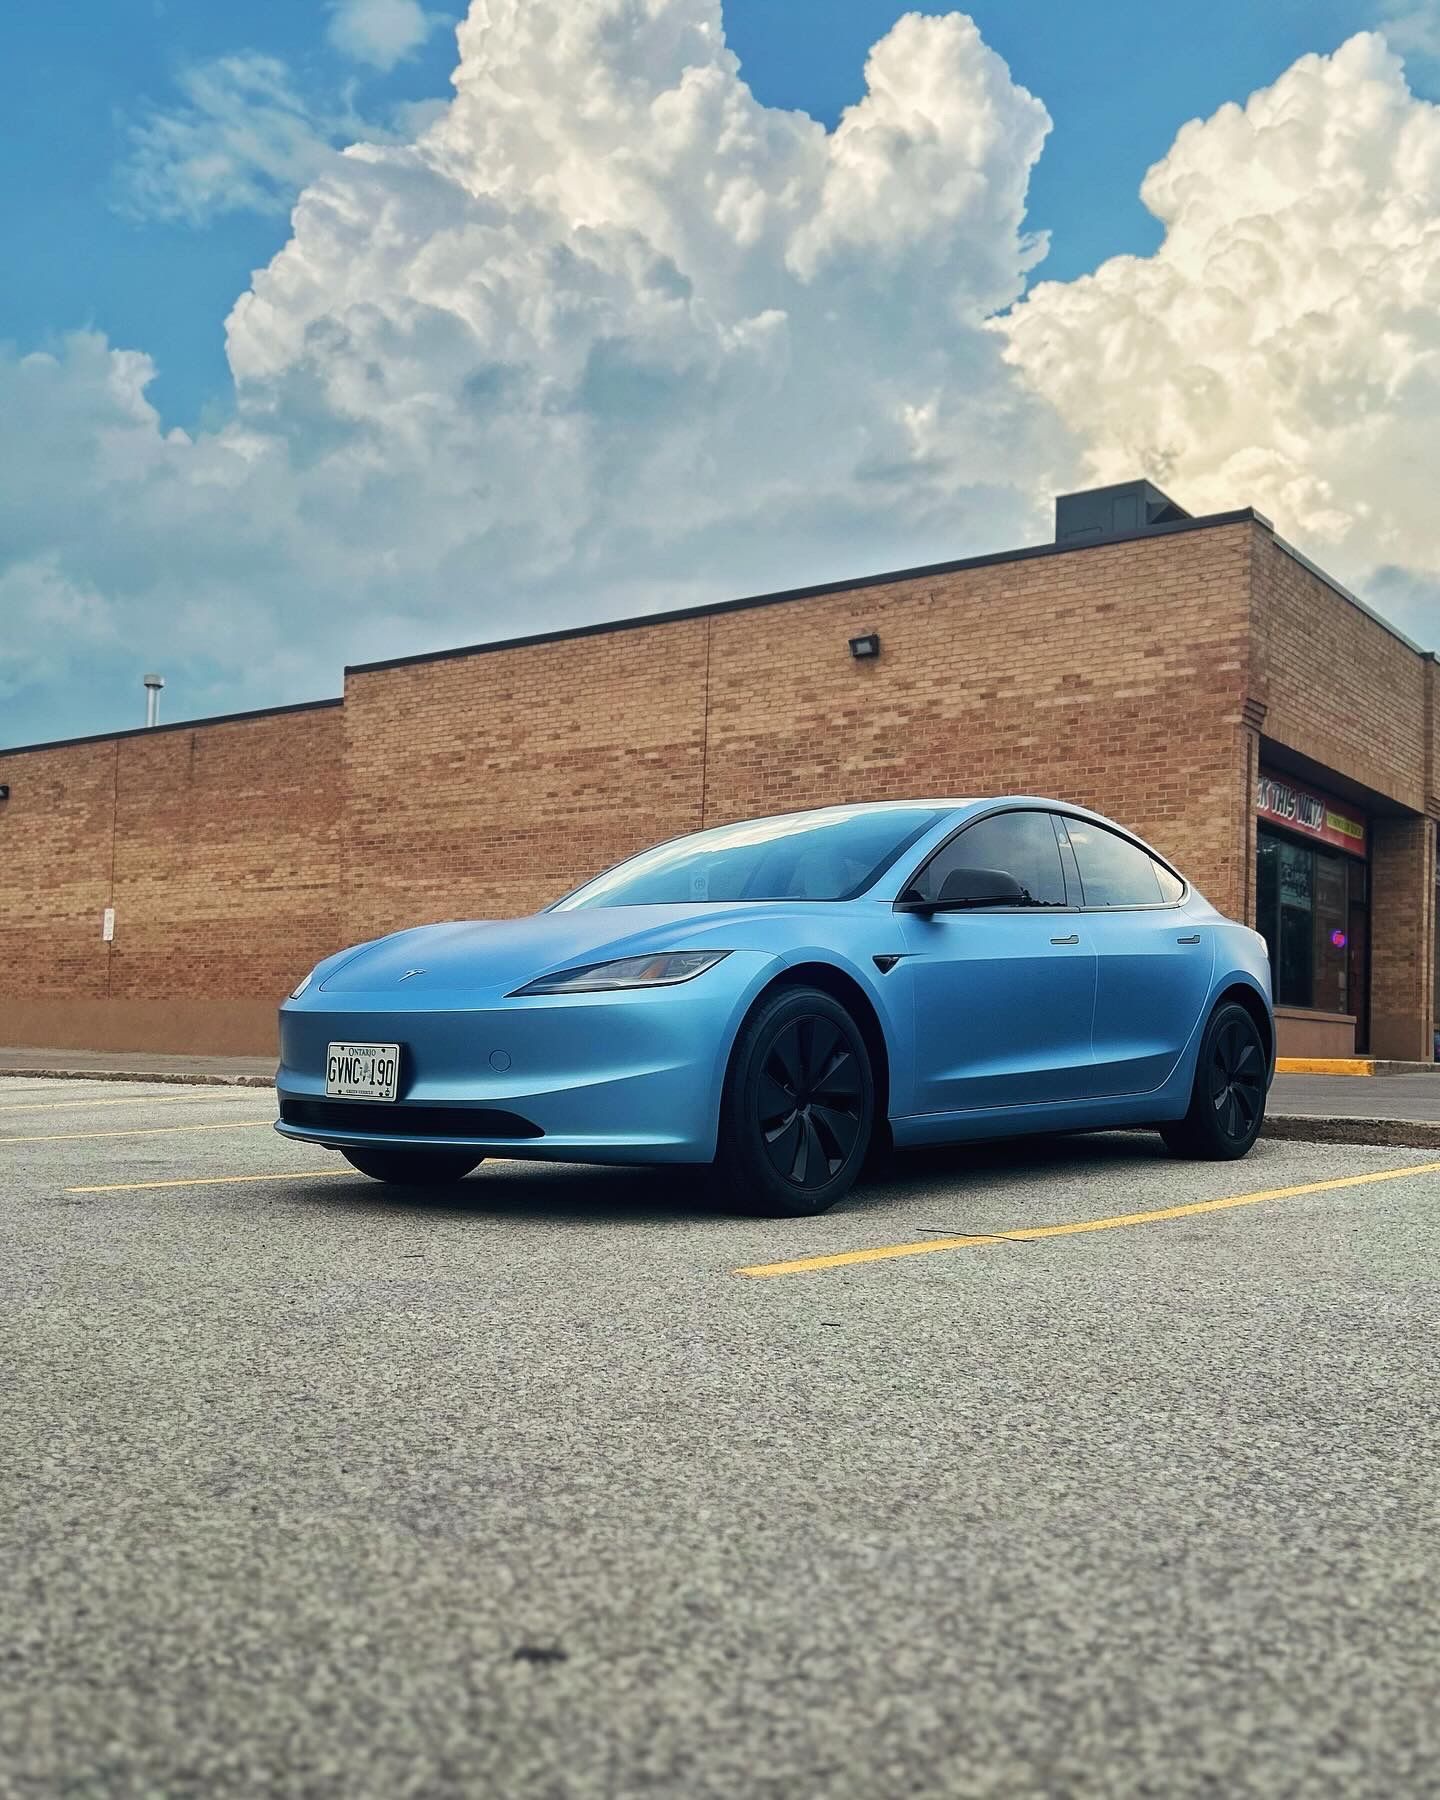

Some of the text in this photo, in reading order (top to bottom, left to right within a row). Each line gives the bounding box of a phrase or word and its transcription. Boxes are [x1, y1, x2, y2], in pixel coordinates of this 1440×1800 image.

[1271, 782, 1297, 820] THIS
[349, 1048, 376, 1057] ONTARIO
[328, 1056, 394, 1087] GVNC 190
